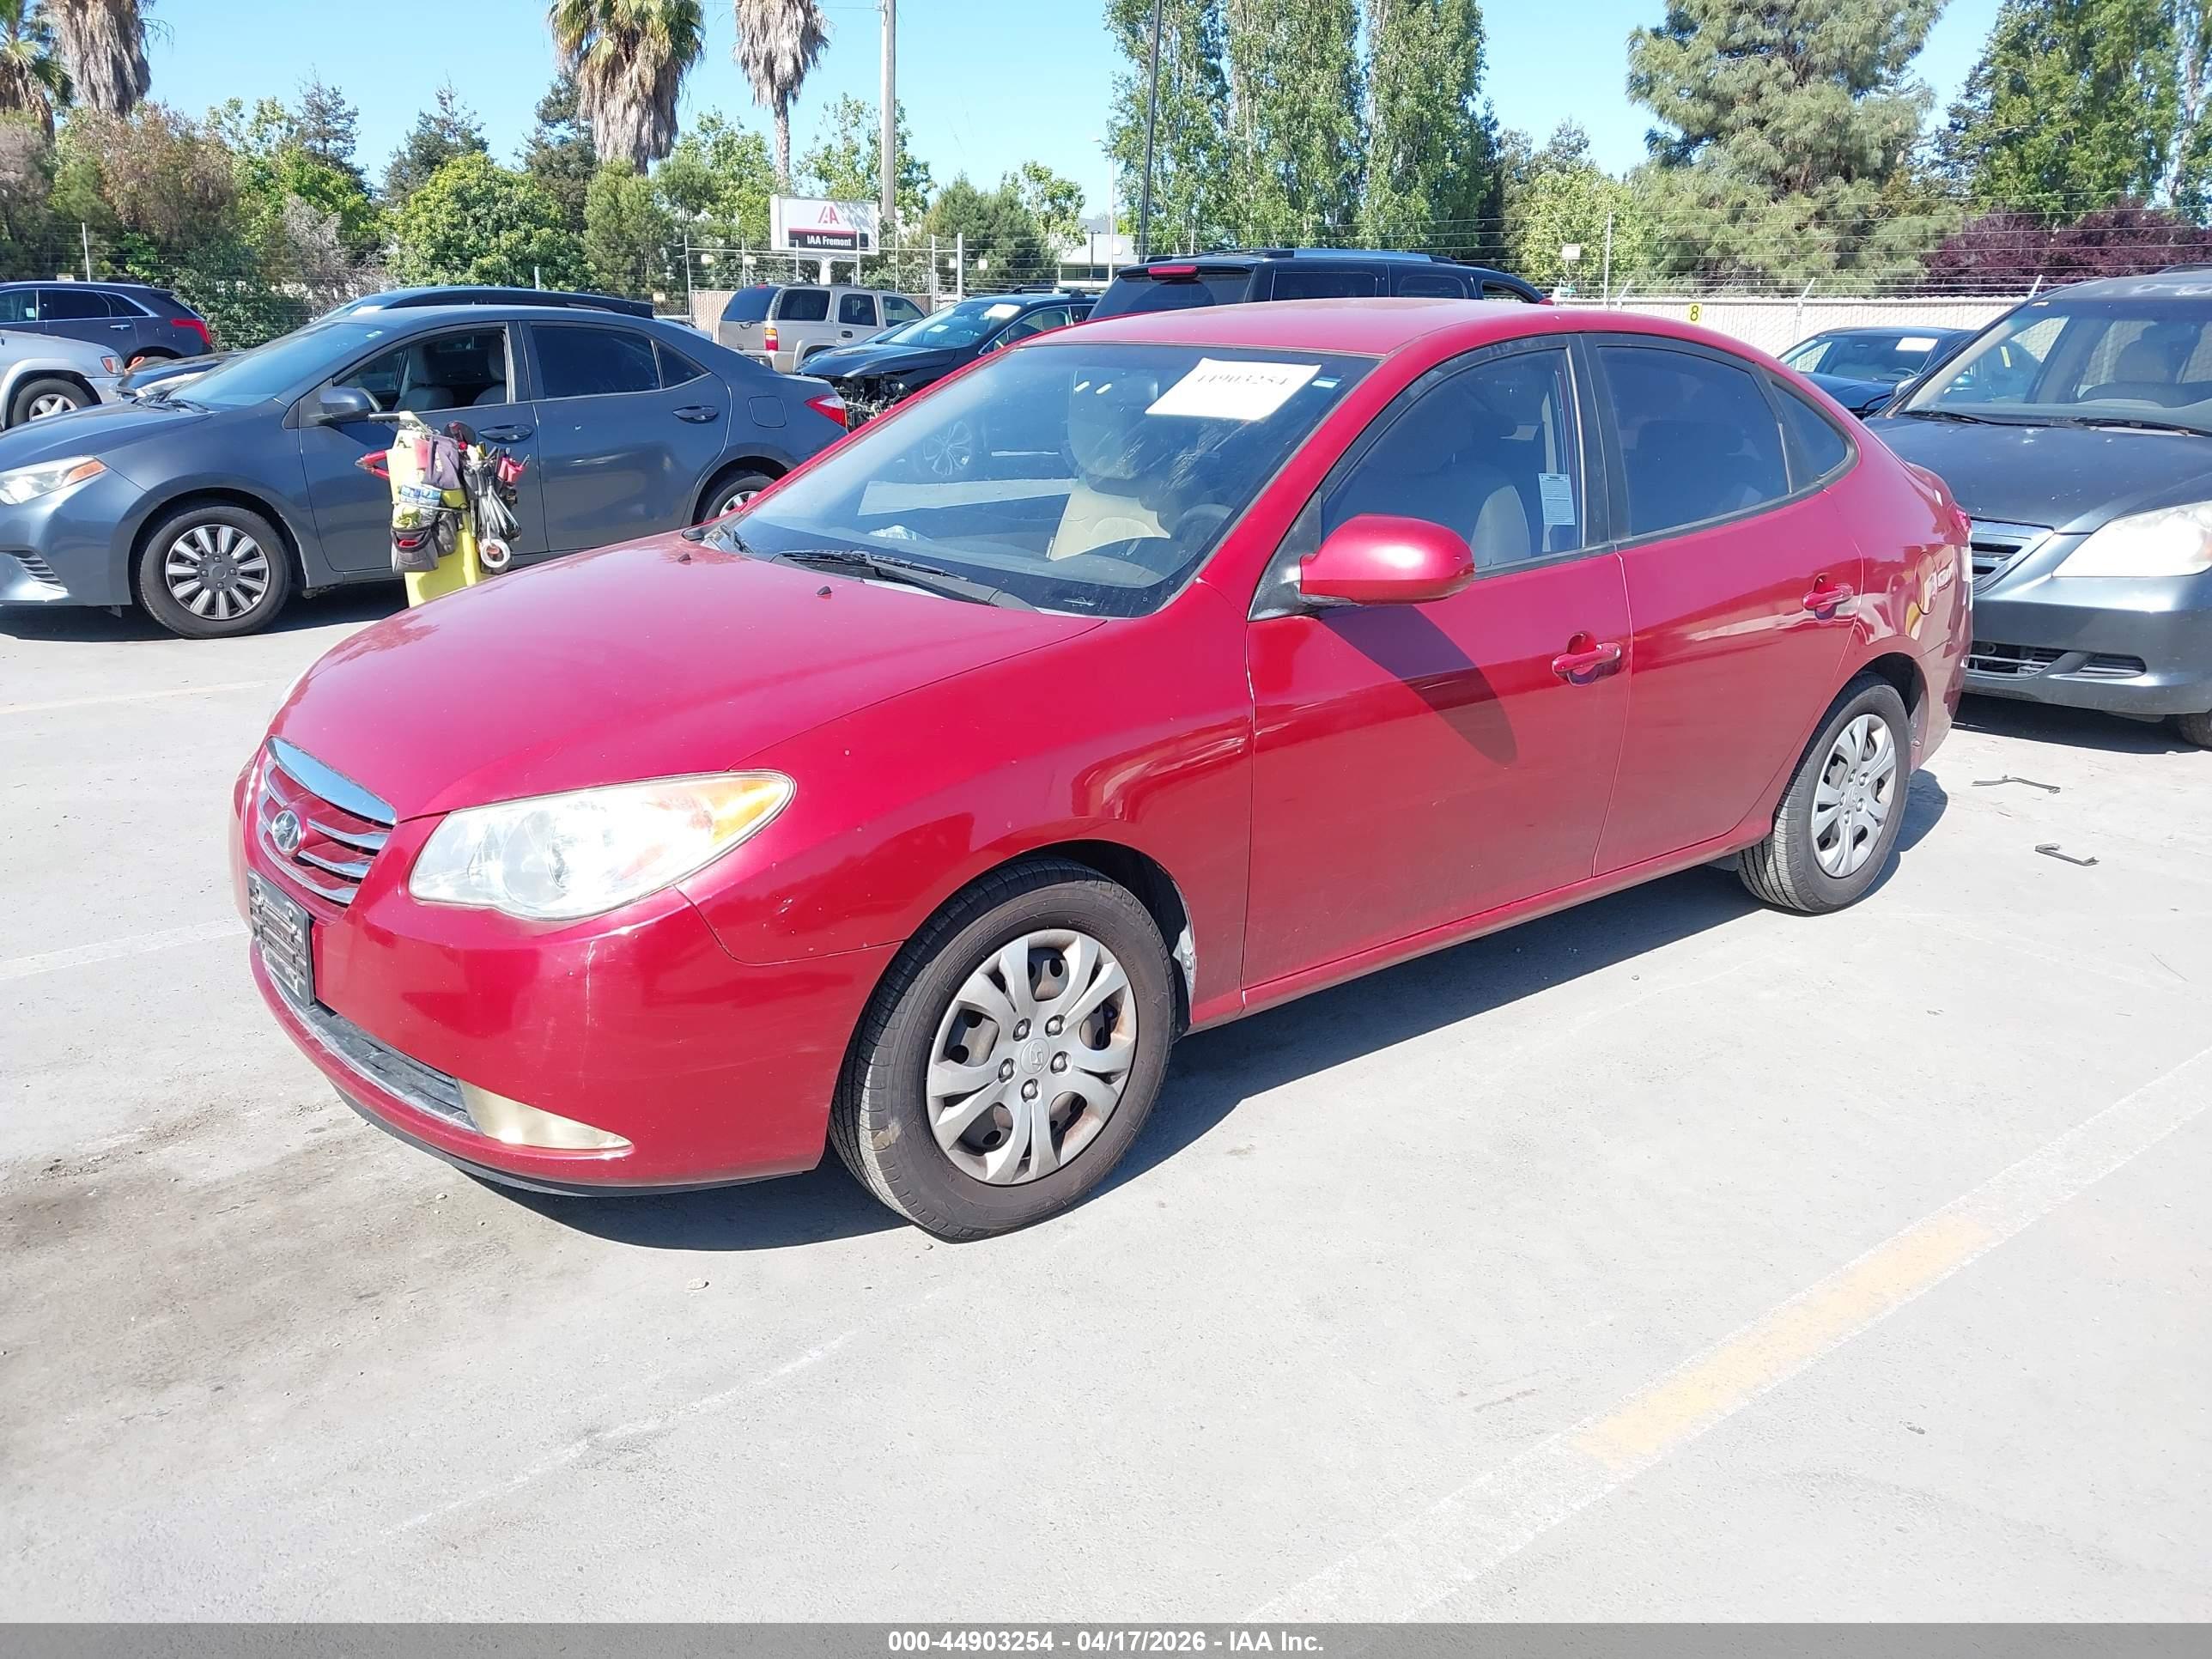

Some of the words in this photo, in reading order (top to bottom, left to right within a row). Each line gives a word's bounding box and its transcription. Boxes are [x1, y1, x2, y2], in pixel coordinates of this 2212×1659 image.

[807, 235, 821, 245] IAA
[823, 236, 852, 246] Fremont
[1690, 305, 1698, 321] 8
